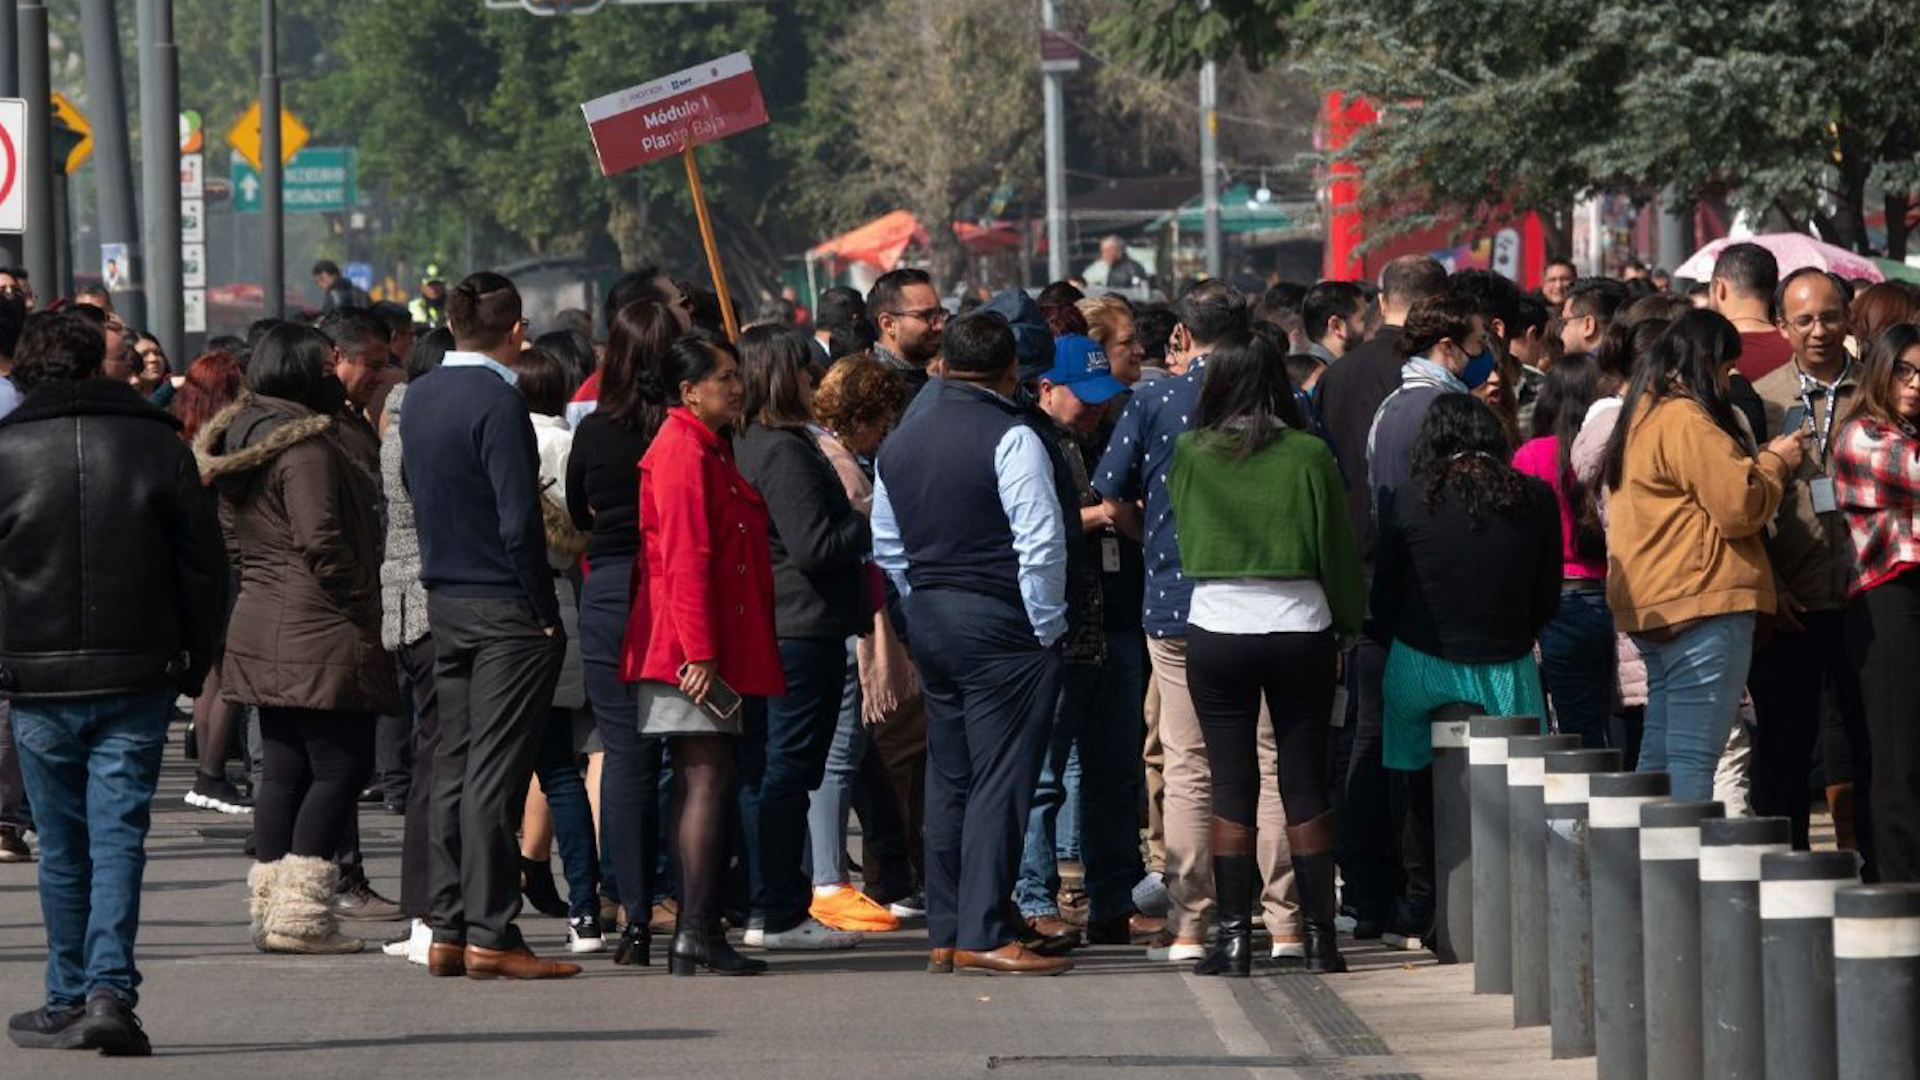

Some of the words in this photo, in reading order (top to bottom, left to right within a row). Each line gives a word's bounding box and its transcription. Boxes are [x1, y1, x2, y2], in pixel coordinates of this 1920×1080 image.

[642, 100, 699, 129] Módulo
[641, 130, 688, 152] Planta
[692, 117, 725, 136] Baja
